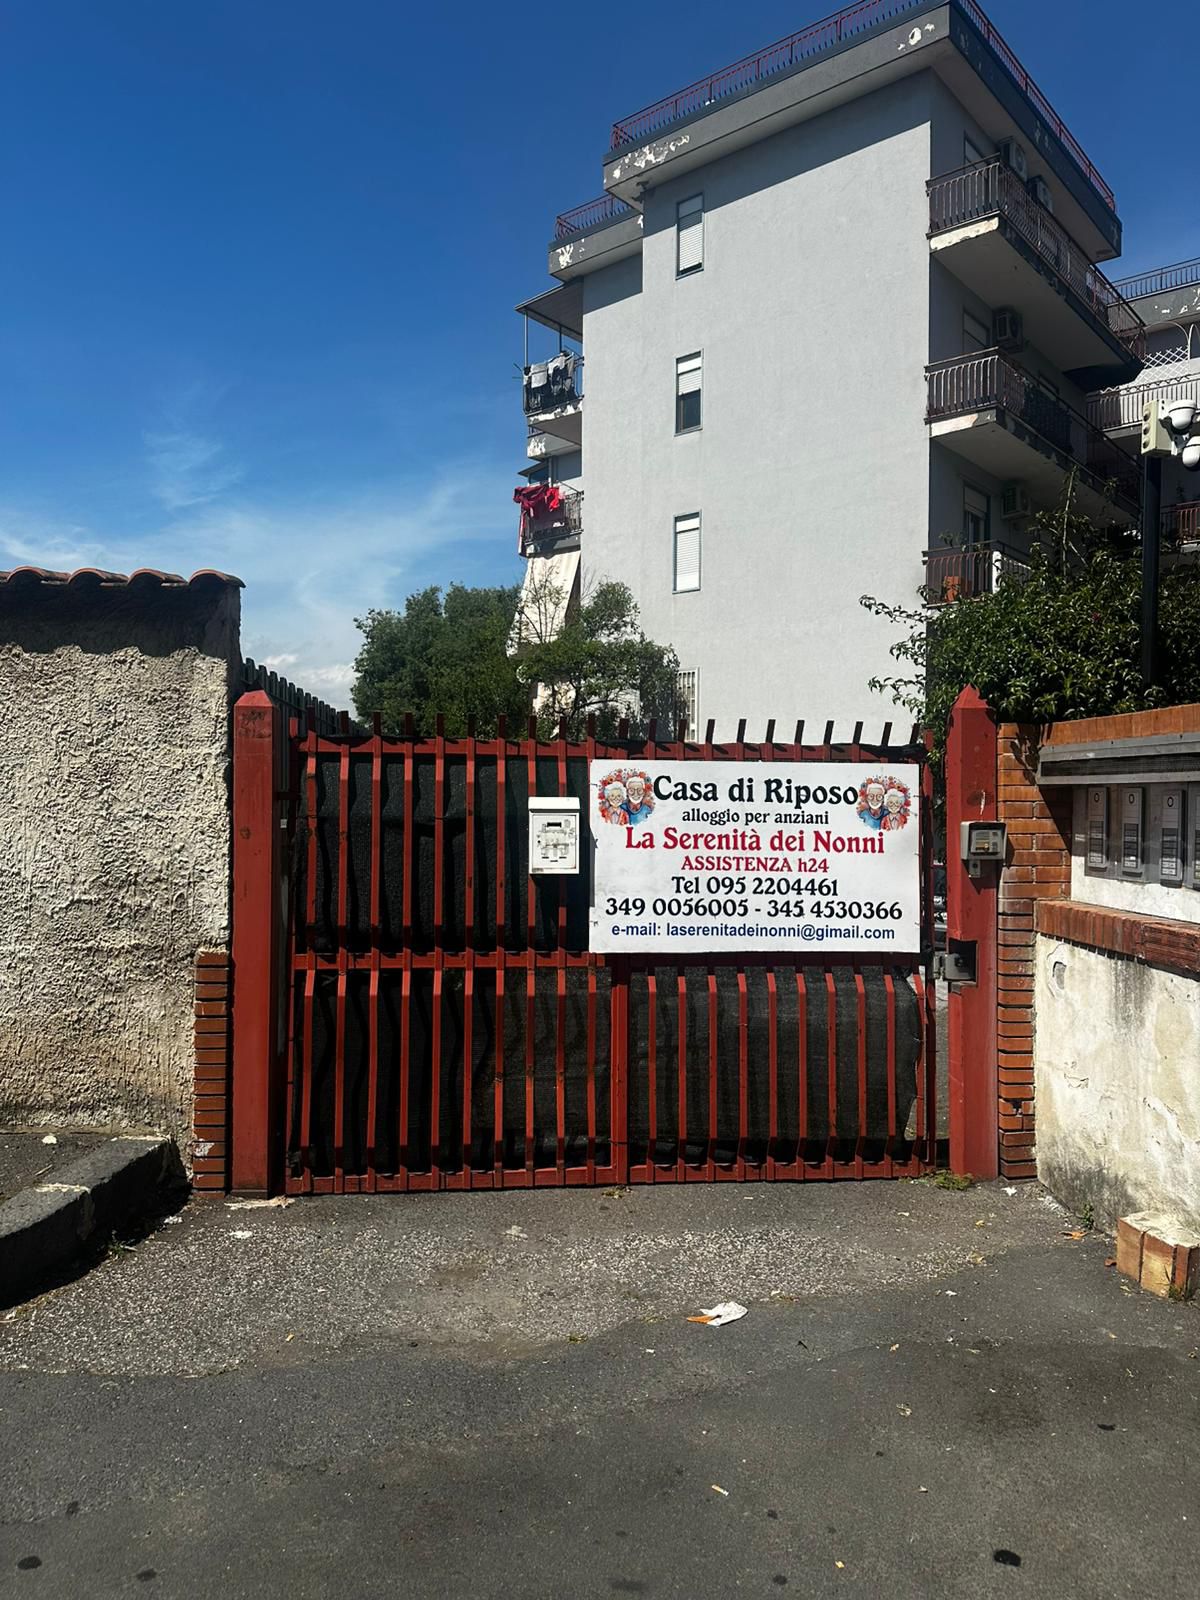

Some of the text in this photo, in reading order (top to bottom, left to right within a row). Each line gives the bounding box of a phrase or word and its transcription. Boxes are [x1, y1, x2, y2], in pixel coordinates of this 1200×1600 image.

[653, 775, 858, 809] Casa di Riposo
[682, 809, 828, 825] alloggio per anziani
[626, 827, 884, 853] La Serenità dei Nonni
[681, 856, 829, 872] ASSISTENZA h24
[671, 877, 838, 896] Tel 095 2204461
[606, 898, 645, 916] 349
[653, 898, 748, 917] 0056005
[767, 900, 805, 917] 345
[810, 901, 902, 919] 4530366
[611, 922, 894, 941] e-mail: laserenitadeinonni@gimail.com
